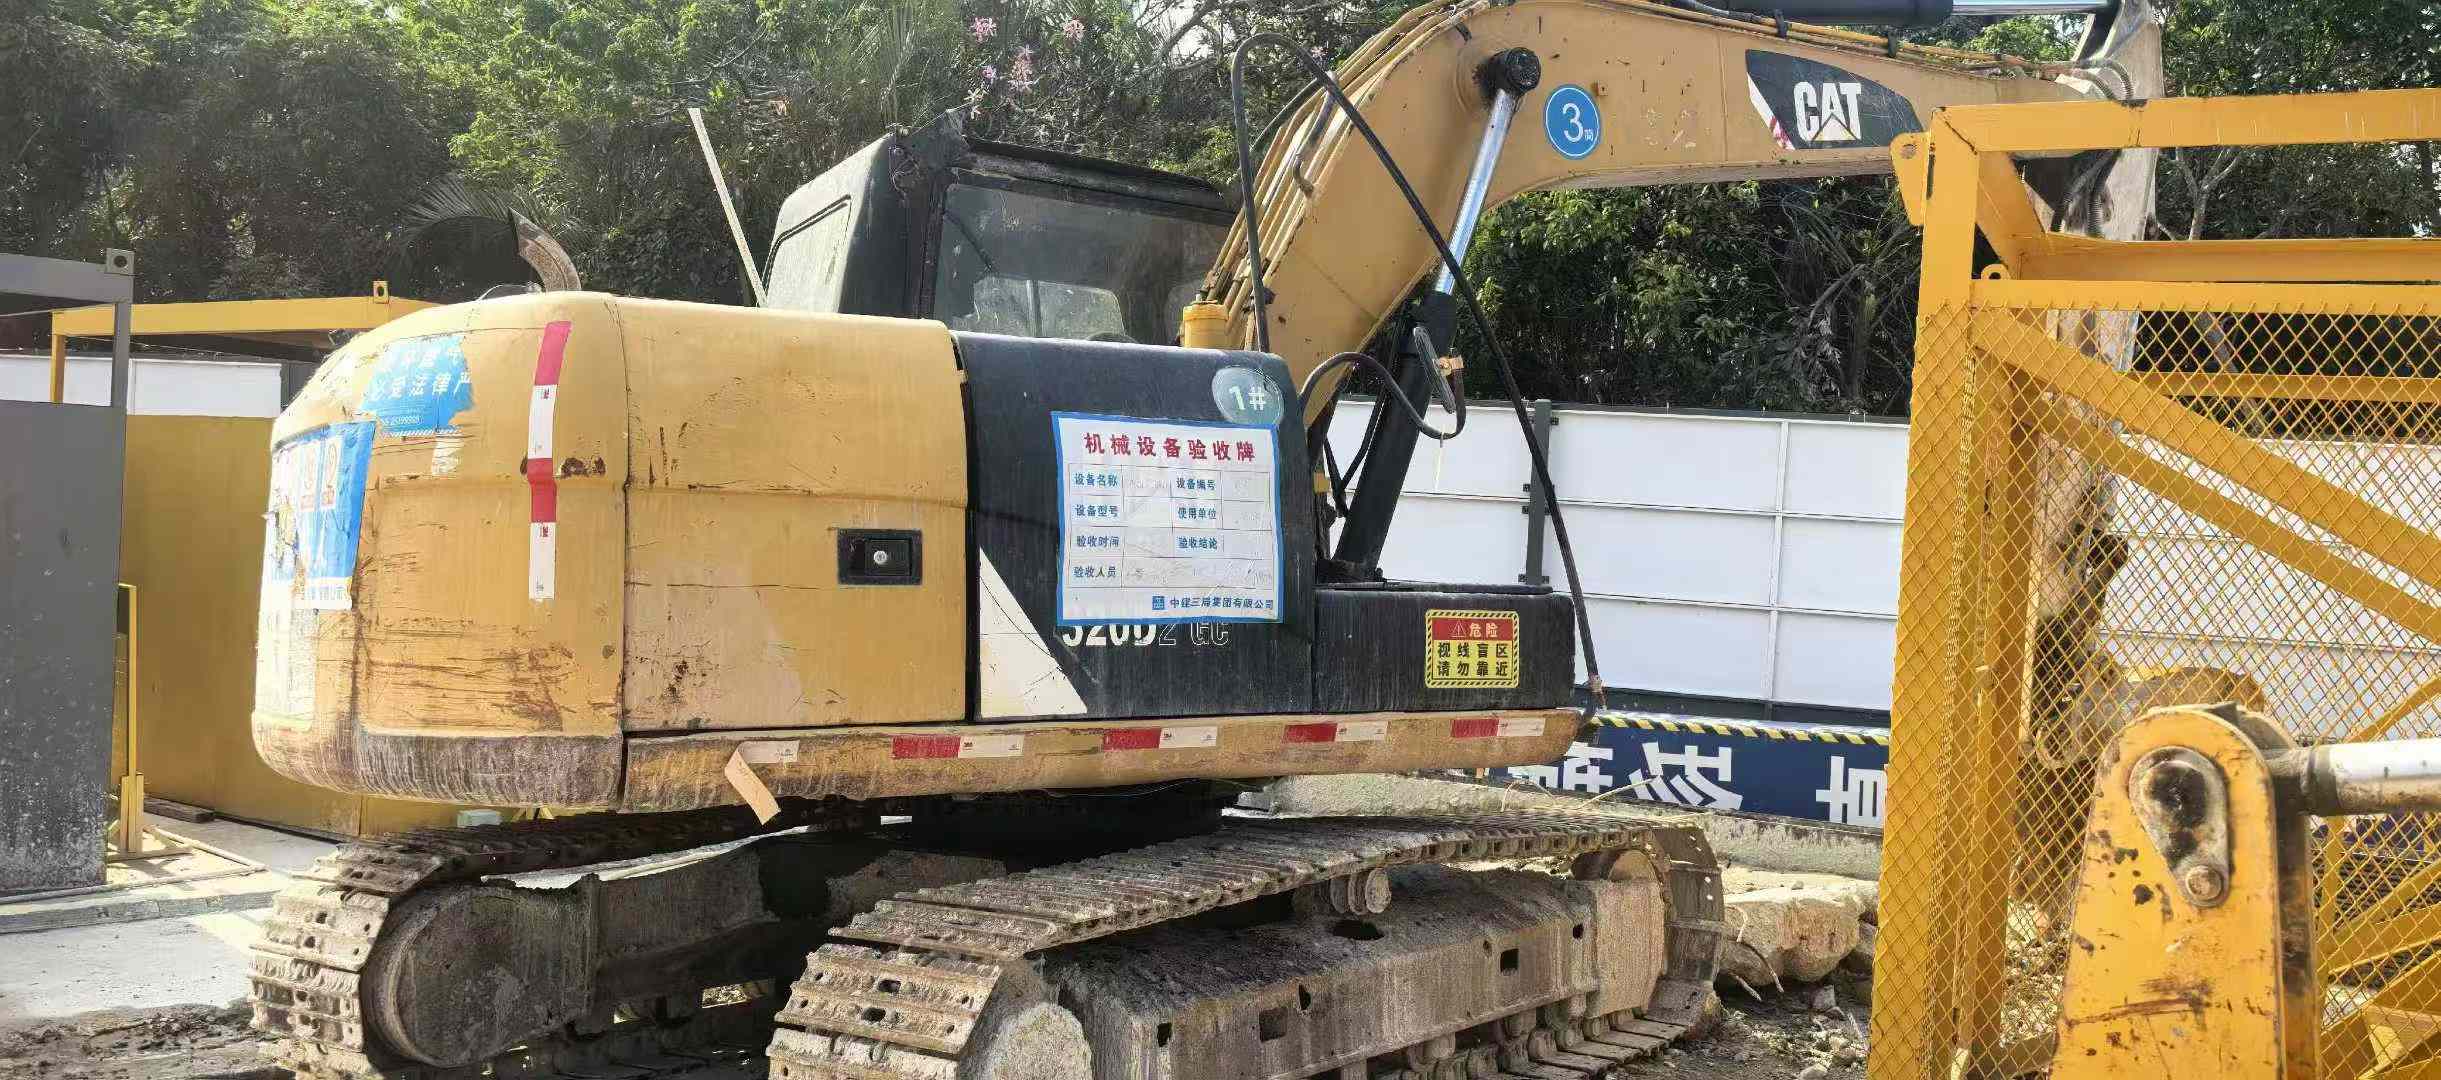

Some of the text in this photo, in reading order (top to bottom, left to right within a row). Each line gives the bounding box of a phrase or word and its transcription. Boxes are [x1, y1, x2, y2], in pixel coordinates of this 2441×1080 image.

[1794, 81, 1861, 141] CAT
[1229, 385, 1266, 411] 1#
[1084, 432, 1255, 461] 机械设备验收牌
[1074, 473, 1118, 487] 设备名称
[1176, 478, 1215, 490] 设备编号
[1075, 504, 1119, 517] 设备型号
[1178, 507, 1216, 520] 使用单位
[1076, 535, 1119, 548] 验收时间
[1178, 536, 1217, 549] 验收结论
[1073, 566, 1117, 578] 验收人员
[1170, 595, 1273, 610] 中建三局集团有限公司
[1470, 622, 1498, 637] 危险
[1438, 642, 1508, 658] 视线盲区
[1437, 661, 1508, 676] 请勿靠近
